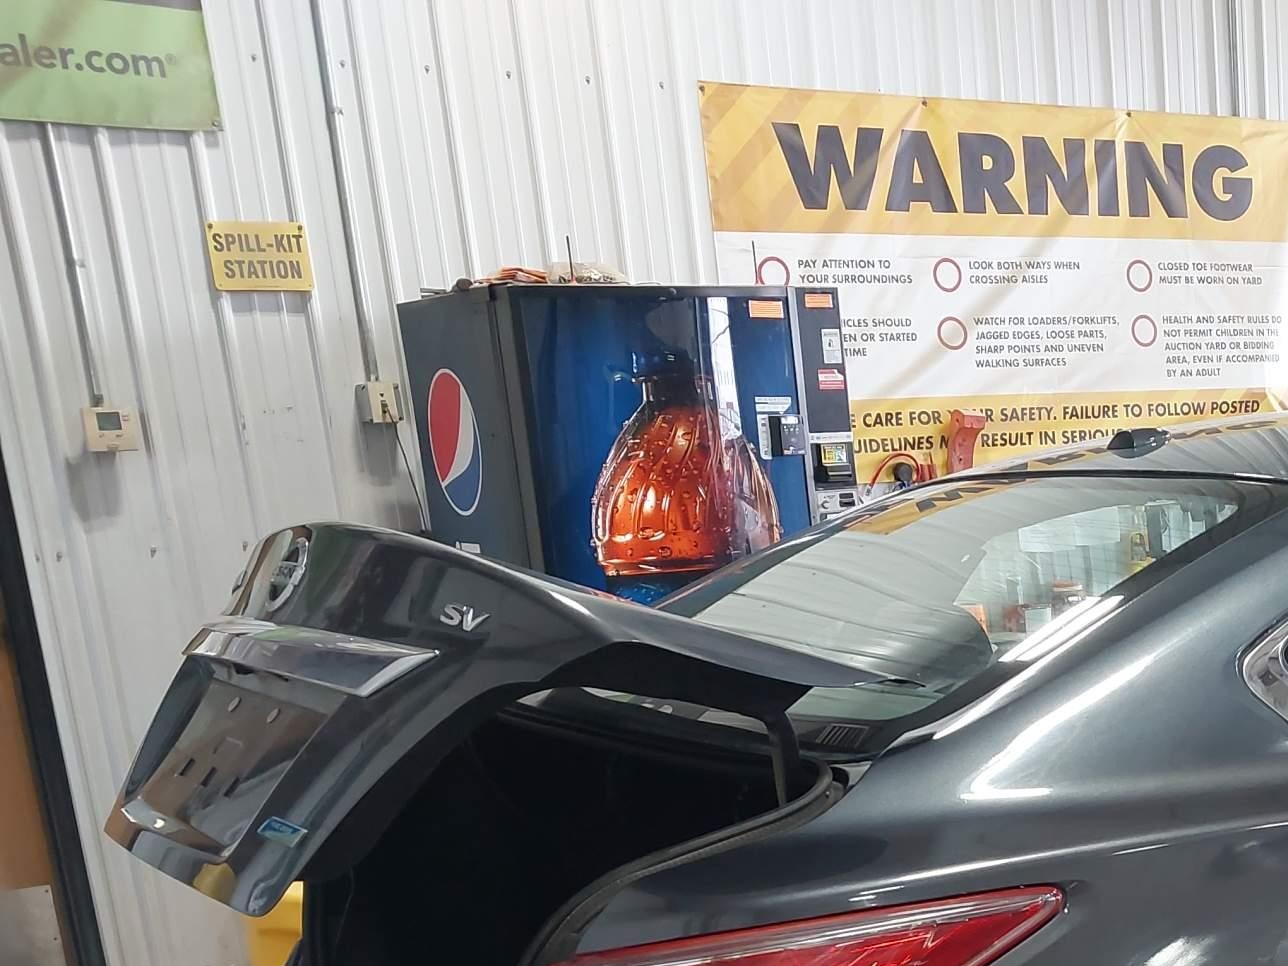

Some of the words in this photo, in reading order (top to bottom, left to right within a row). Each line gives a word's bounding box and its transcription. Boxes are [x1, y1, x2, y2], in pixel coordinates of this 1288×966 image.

[772, 122, 1254, 221] WARNING
[212, 232, 303, 253] SPILL-KIT
[223, 259, 302, 279] STATION
[797, 259, 817, 269] PAY
[822, 259, 875, 269] ATTENTION
[879, 259, 891, 269] TO
[968, 261, 994, 270] LOOK
[997, 261, 1023, 270] BOTH
[1025, 261, 1051, 270] WAYS
[1053, 261, 1080, 270] WHEN
[1157, 262, 1189, 271] CLOSED
[1192, 262, 1208, 271] TOE
[1210, 263, 1253, 272] FOOTWEAR
[800, 274, 829, 284] YOUR
[831, 274, 913, 284] SURROUNDINGS
[969, 275, 1018, 284] CROSSING
[1021, 275, 1048, 284] AISLES
[1159, 276, 1182, 284] MUST
[1184, 276, 1195, 284] BE
[1196, 276, 1224, 284] WORN
[1226, 277, 1239, 285] ON
[1241, 277, 1263, 285] YARD
[842, 318, 869, 328] ICLES
[872, 318, 912, 328] SHOULD
[973, 317, 1006, 326] WATCH
[1008, 317, 1025, 326] FOR
[1028, 316, 1120, 326] LOADERS/FORKLIFTS,
[1162, 315, 1193, 324] HEALTH
[1195, 315, 1215, 324] AND
[1217, 315, 1244, 324] SAFETY
[1247, 315, 1270, 323] RULES
[1271, 315, 1282, 323] DO
[860, 333, 876, 342] OR
[879, 332, 917, 342] STARTED
[976, 331, 1010, 340] JAGGED
[1012, 331, 1044, 341] EDGES,
[1046, 330, 1075, 340] LOOSE
[1078, 330, 1107, 340] PARTS,
[1163, 329, 1181, 337] NOT
[1183, 329, 1213, 337] PERMIT
[1215, 328, 1254, 337] CHILDREN
[1256, 328, 1265, 336] IN
[1266, 328, 1279, 336] THE
[975, 345, 1004, 354] SHARP
[1007, 344, 1041, 354] POINTS
[1044, 344, 1064, 353] AND
[1067, 343, 1104, 352] UNEVEN
[1164, 342, 1202, 351] AUCTION
[1204, 342, 1226, 350] YARD
[1229, 342, 1241, 350] OR
[1243, 341, 1275, 350] BIDDING
[844, 347, 867, 357] TIME
[975, 359, 1020, 368] WALKING
[1022, 358, 1067, 368] SURFACES
[1166, 355, 1190, 365] AREA,
[1192, 355, 1214, 363] EVEN
[1216, 355, 1223, 363] IF
[1225, 354, 1280, 363] ACCOMPANIED
[1166, 369, 1177, 377] BY
[1179, 369, 1193, 377] AN
[1195, 368, 1221, 377] ADULT
[862, 412, 903, 427] CARE
[909, 410, 943, 425] FOR
[1000, 406, 1057, 422] SAFETY.
[1063, 404, 1118, 420] FAILURE
[1123, 403, 1143, 418] TO
[1148, 401, 1206, 417] FOLLOW
[1210, 399, 1260, 414] POSTED
[981, 432, 1034, 448] RESULT
[1039, 431, 1056, 445] IN
[440, 604, 490, 631] SV
